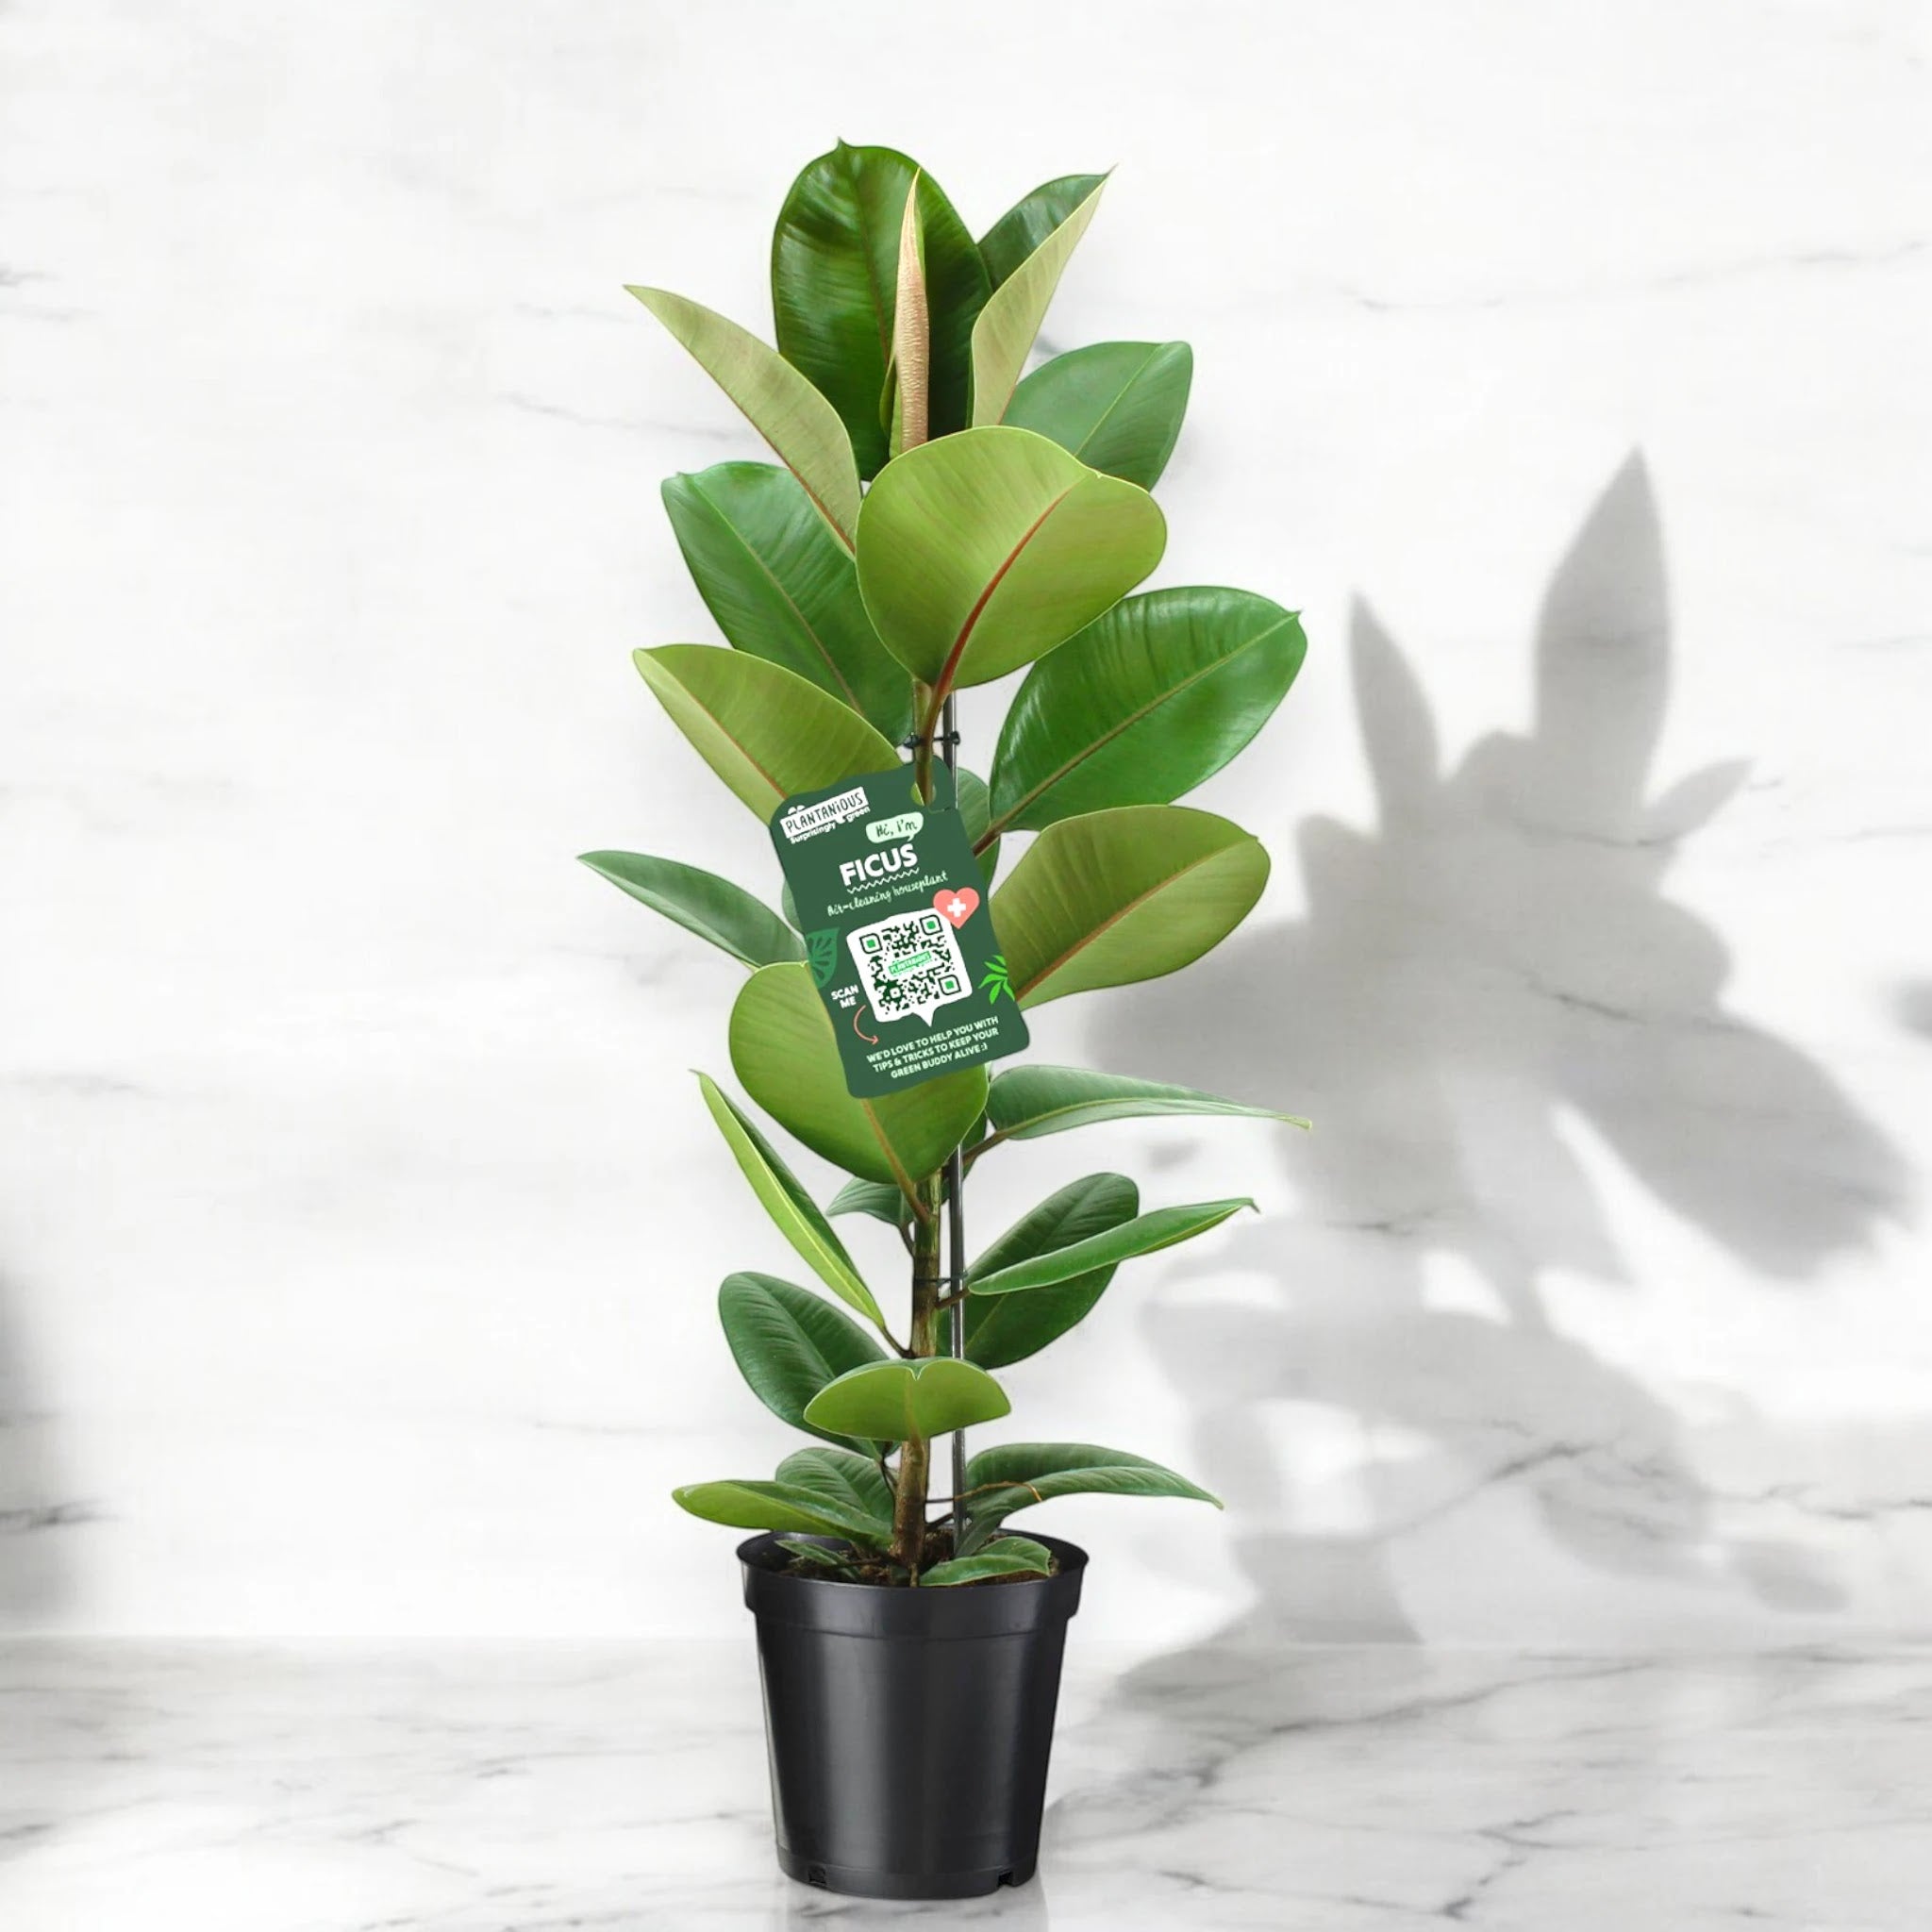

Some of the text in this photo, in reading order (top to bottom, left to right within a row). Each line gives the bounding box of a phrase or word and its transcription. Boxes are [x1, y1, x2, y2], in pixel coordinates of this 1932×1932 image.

[790, 806, 870, 844] Surprisingly green
[875, 819, 918, 838] Hi, I'm
[839, 843, 918, 886] FICUS
[827, 870, 948, 916] Air-cleaning houseplant
[831, 984, 859, 1000] SCAN
[840, 996, 857, 1009] ME
[867, 1015, 1000, 1063] WE'D LOVE TO HELP YOU WITH
[873, 1026, 1000, 1073] TIPS & TRICKS TO KEEP YOUR
[890, 1062, 922, 1079] GREEN
[922, 1053, 954, 1070] BUDDY
[954, 1044, 982, 1059] ALIVE
